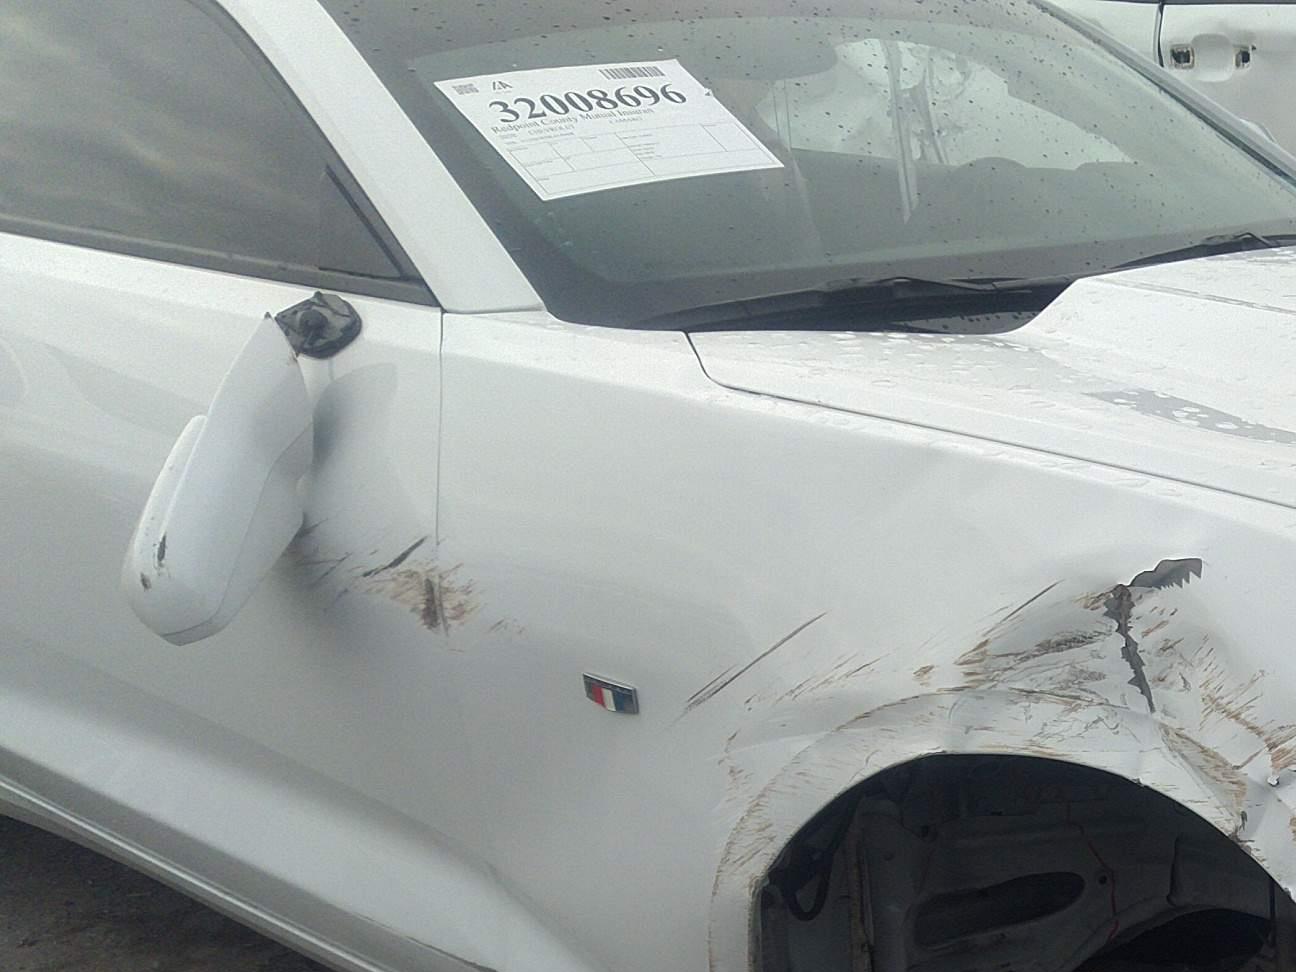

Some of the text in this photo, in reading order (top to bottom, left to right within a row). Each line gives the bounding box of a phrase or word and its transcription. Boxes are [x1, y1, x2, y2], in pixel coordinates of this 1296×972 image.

[489, 83, 687, 123] 32008696
[491, 119, 540, 134] Redpoint
[540, 115, 578, 127] County
[579, 110, 617, 121] Mutual
